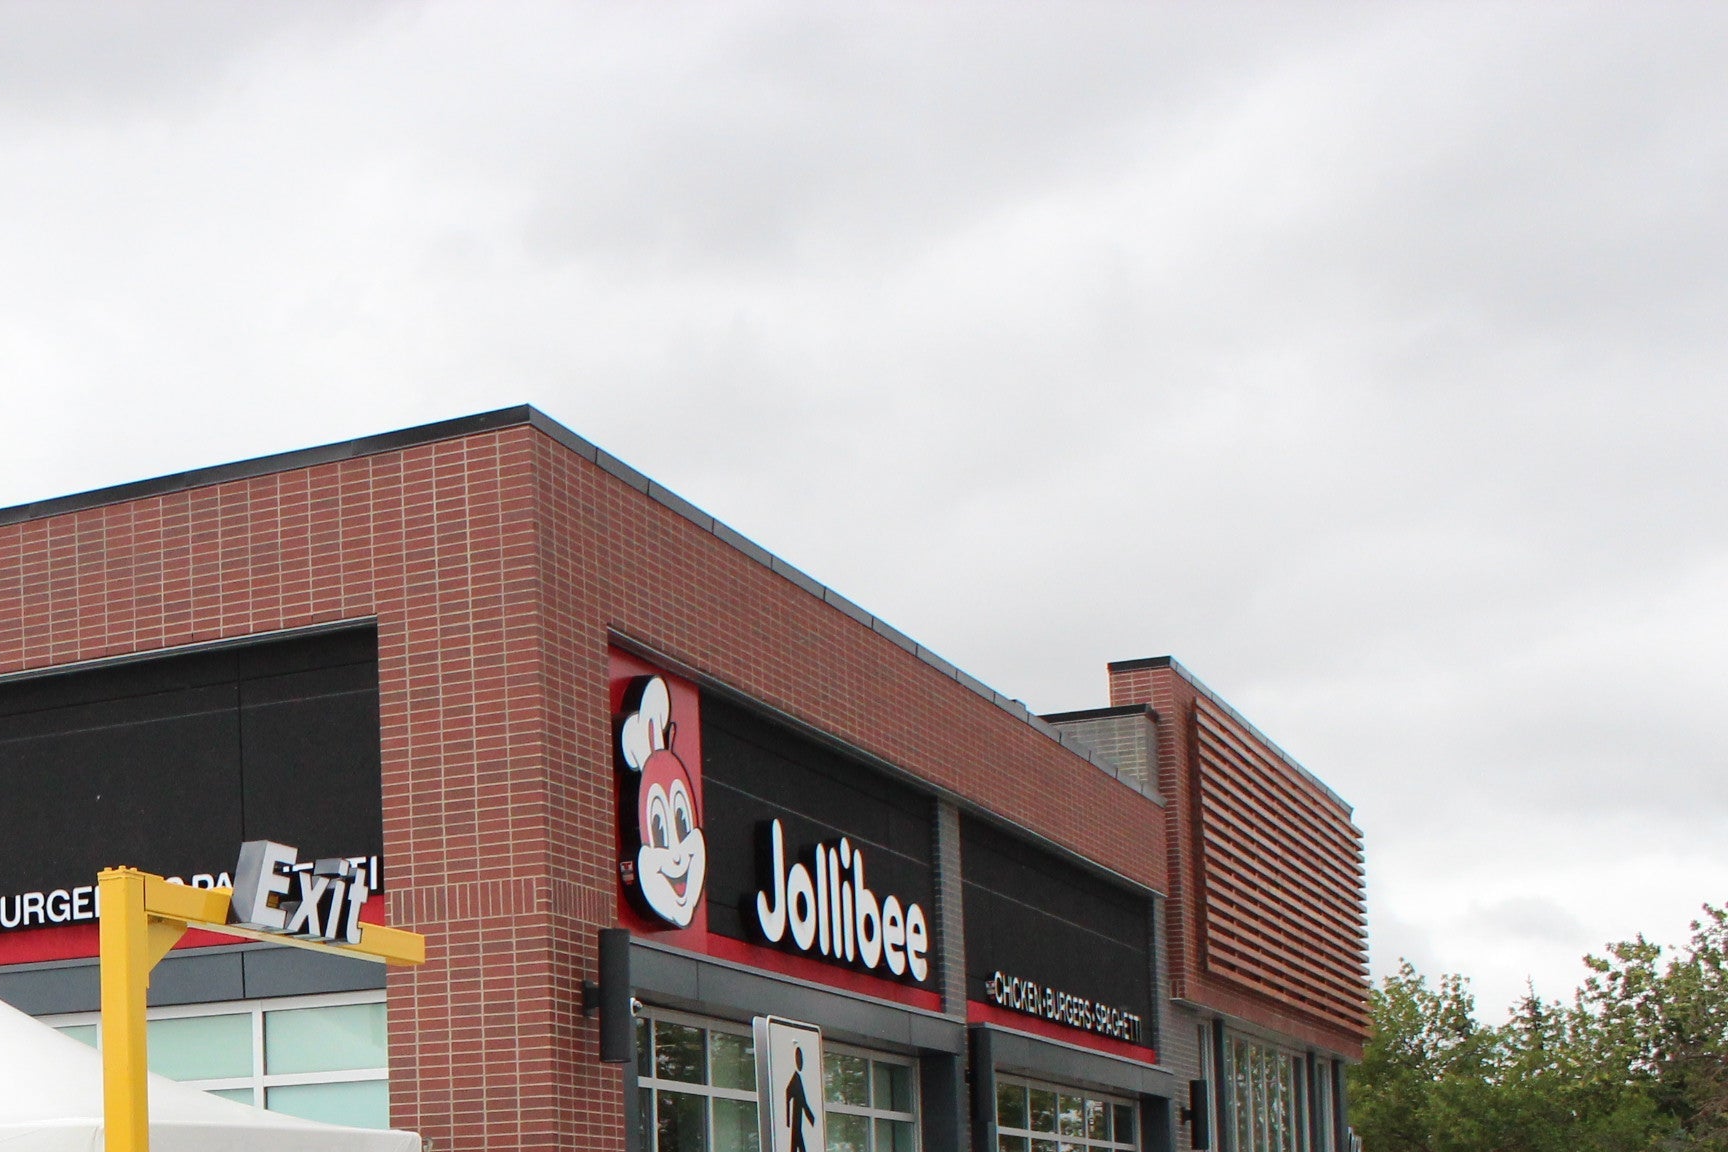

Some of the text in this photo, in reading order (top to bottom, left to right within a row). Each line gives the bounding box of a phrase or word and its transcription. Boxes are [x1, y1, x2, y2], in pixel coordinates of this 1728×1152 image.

[249, 839, 370, 945] Exit
[756, 817, 929, 982] Jollibee
[994, 970, 1042, 1015] CHICKEN
[1045, 987, 1092, 1030] BURGERS
[1095, 1002, 1143, 1042] SPAGHETTI
